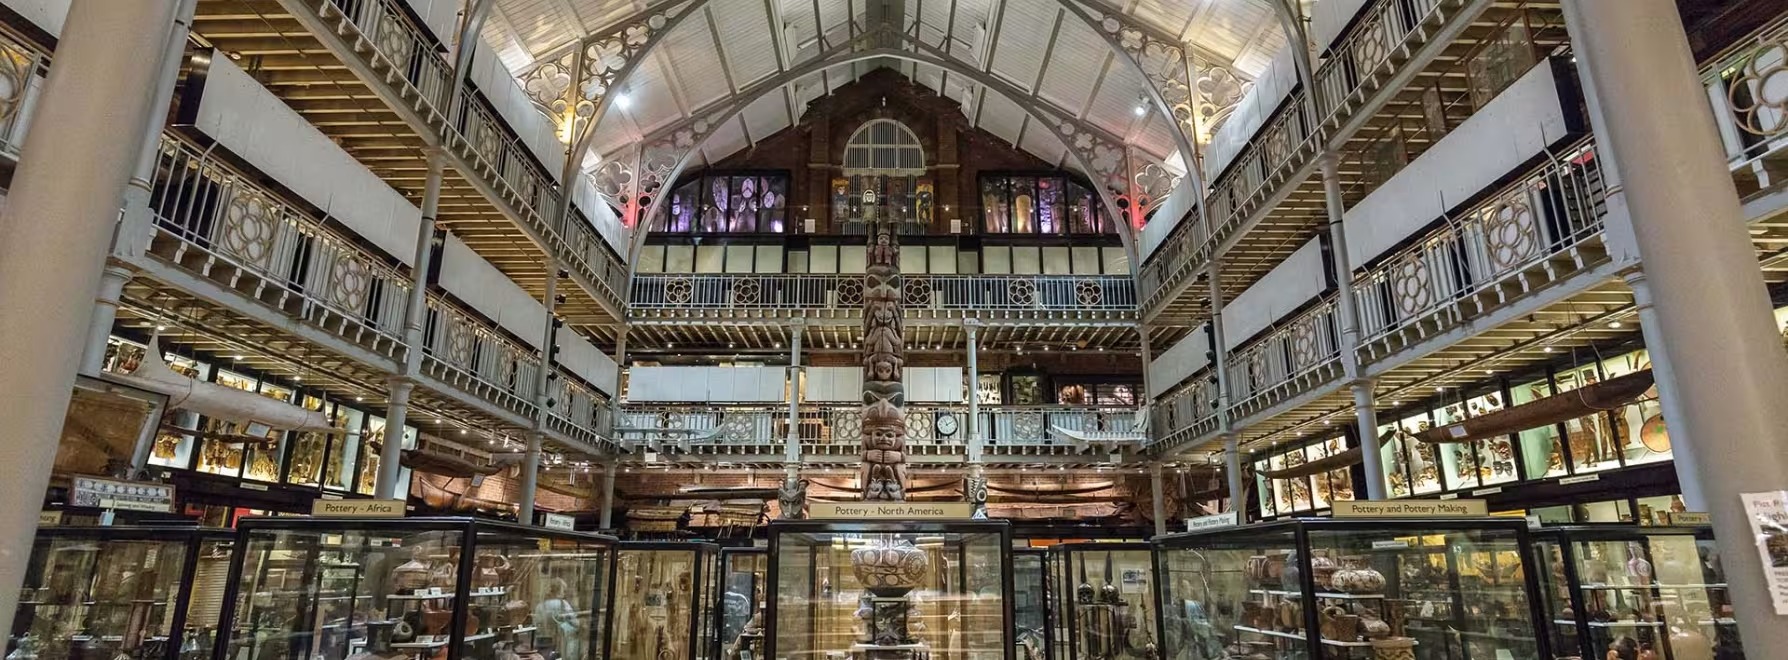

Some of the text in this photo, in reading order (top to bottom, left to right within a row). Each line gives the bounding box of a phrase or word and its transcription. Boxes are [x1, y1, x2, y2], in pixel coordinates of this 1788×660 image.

[325, 503, 358, 514] Pottery
[366, 503, 392, 513] Africa
[835, 506, 868, 516] Pottery
[878, 506, 905, 515] North
[907, 506, 944, 515] America
[1352, 504, 1468, 514] Pottery and Pottery Making
